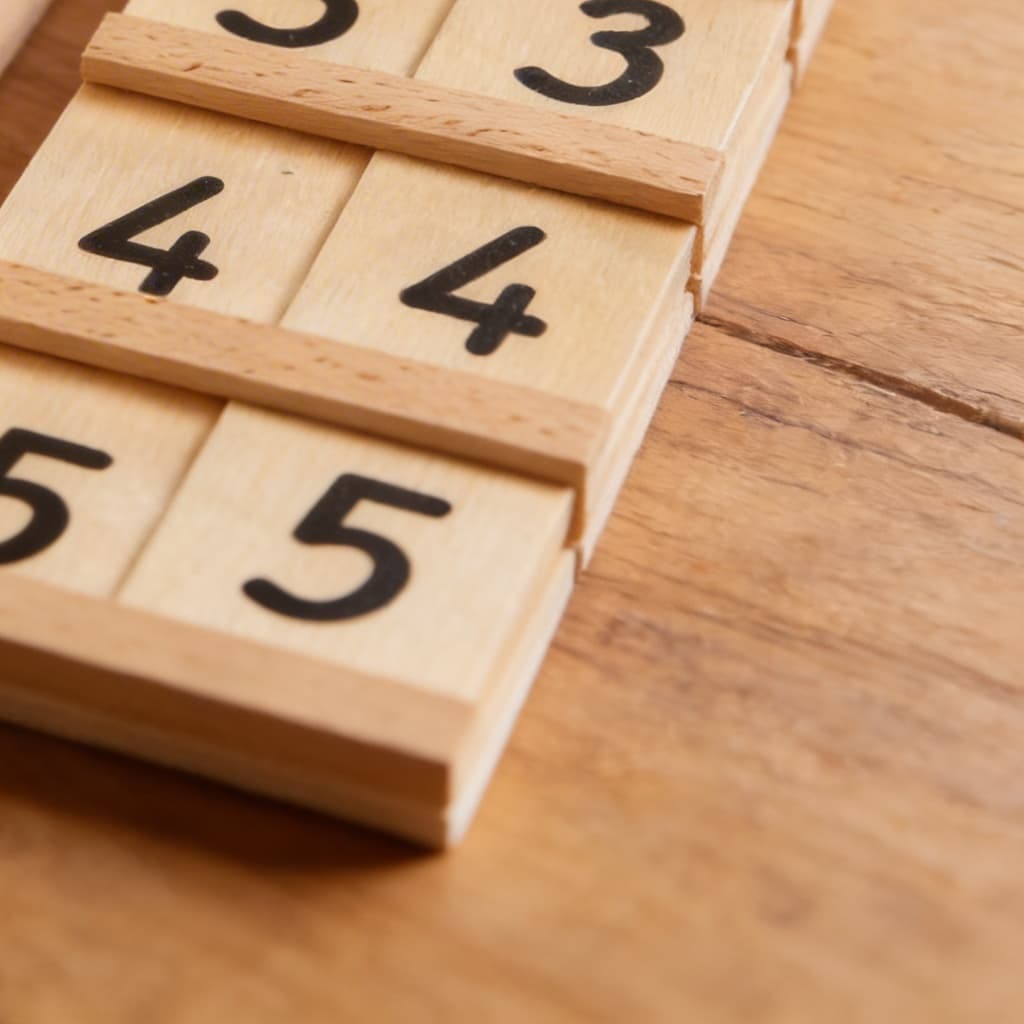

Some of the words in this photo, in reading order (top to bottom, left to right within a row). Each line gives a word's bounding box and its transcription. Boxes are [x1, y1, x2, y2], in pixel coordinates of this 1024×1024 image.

[78, 175, 225, 297] 4
[401, 225, 546, 356] 4
[242, 474, 451, 623] 5
